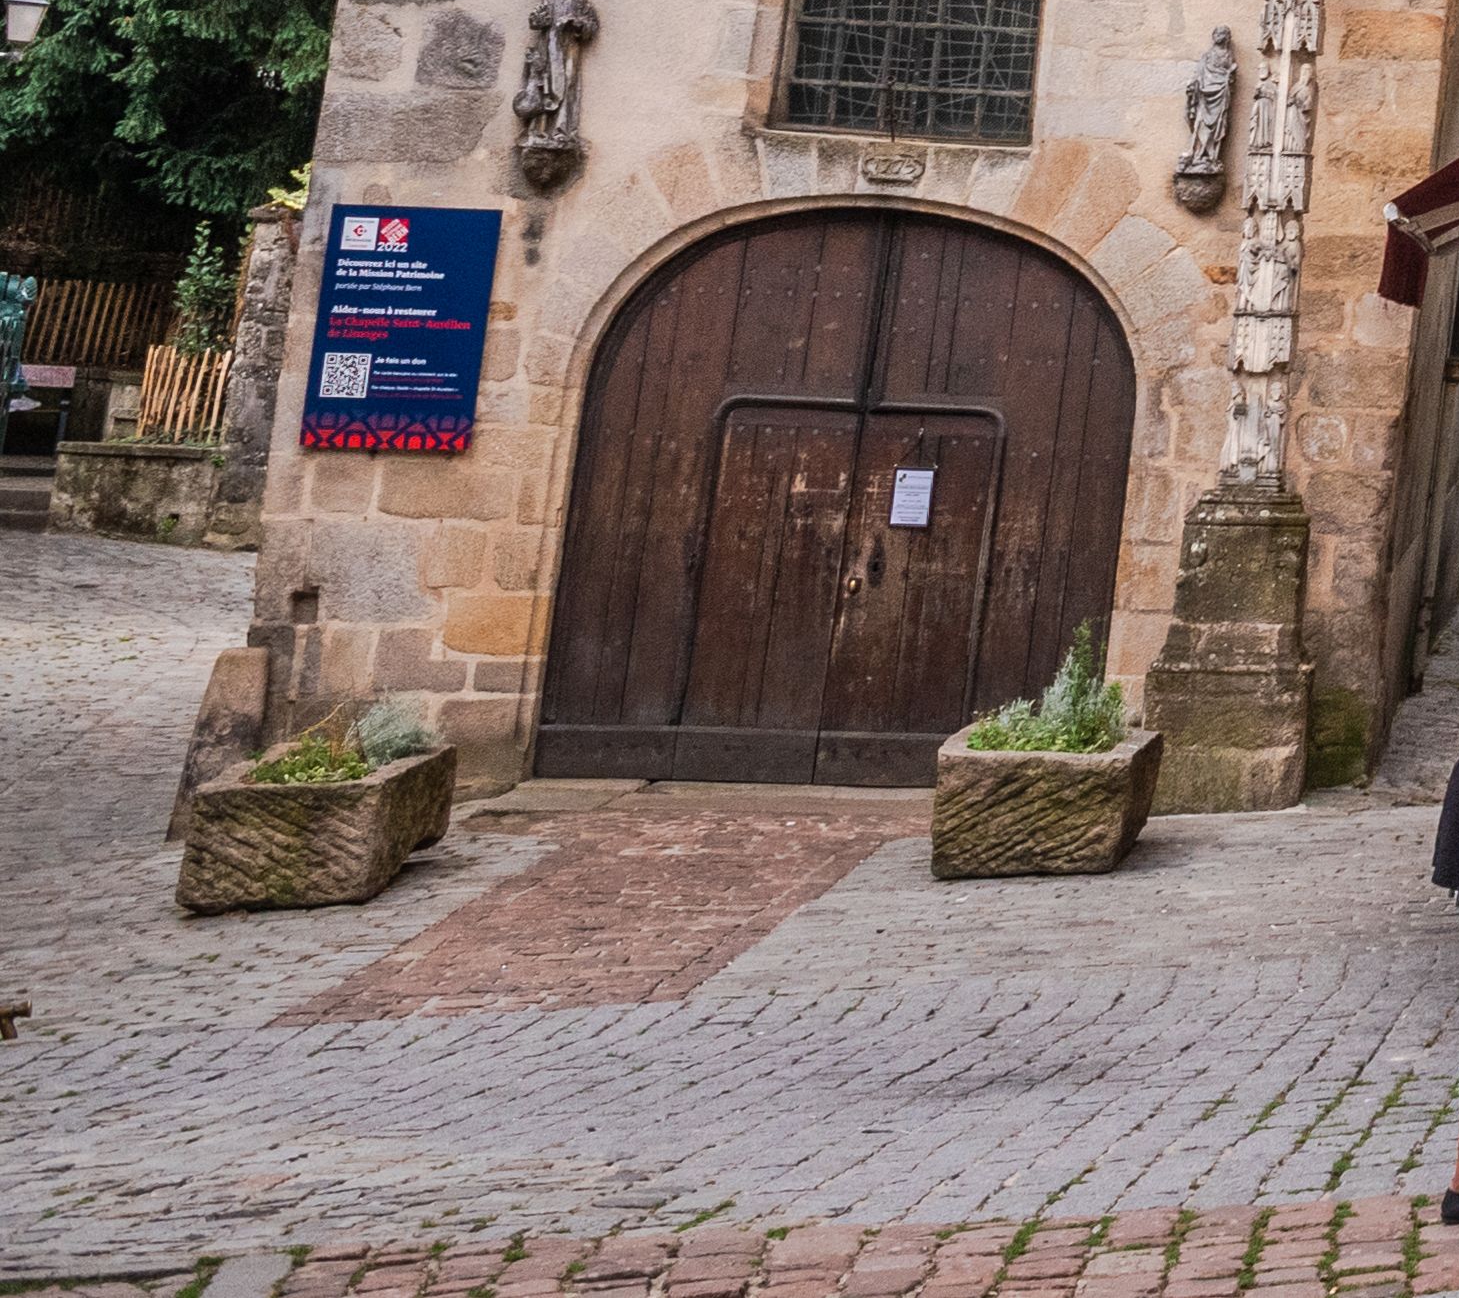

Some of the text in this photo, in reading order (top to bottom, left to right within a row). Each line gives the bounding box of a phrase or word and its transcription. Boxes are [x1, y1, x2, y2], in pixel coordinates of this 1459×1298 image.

[377, 242, 408, 252] 2022
[337, 258, 383, 268] Découvrez
[384, 259, 396, 268] ici
[411, 261, 428, 269] site
[336, 268, 445, 280] de la Mission Patrimoine
[334, 282, 357, 290] portée
[372, 282, 404, 292] Stéphane
[405, 284, 422, 292] Bern
[331, 304, 437, 316] Aidez-nous à restaurer
[329, 316, 471, 330] La Chapelle Saint-Aurélien
[327, 328, 389, 341] de Limoges
[374, 356, 384, 364] Je
[411, 357, 427, 365] don
